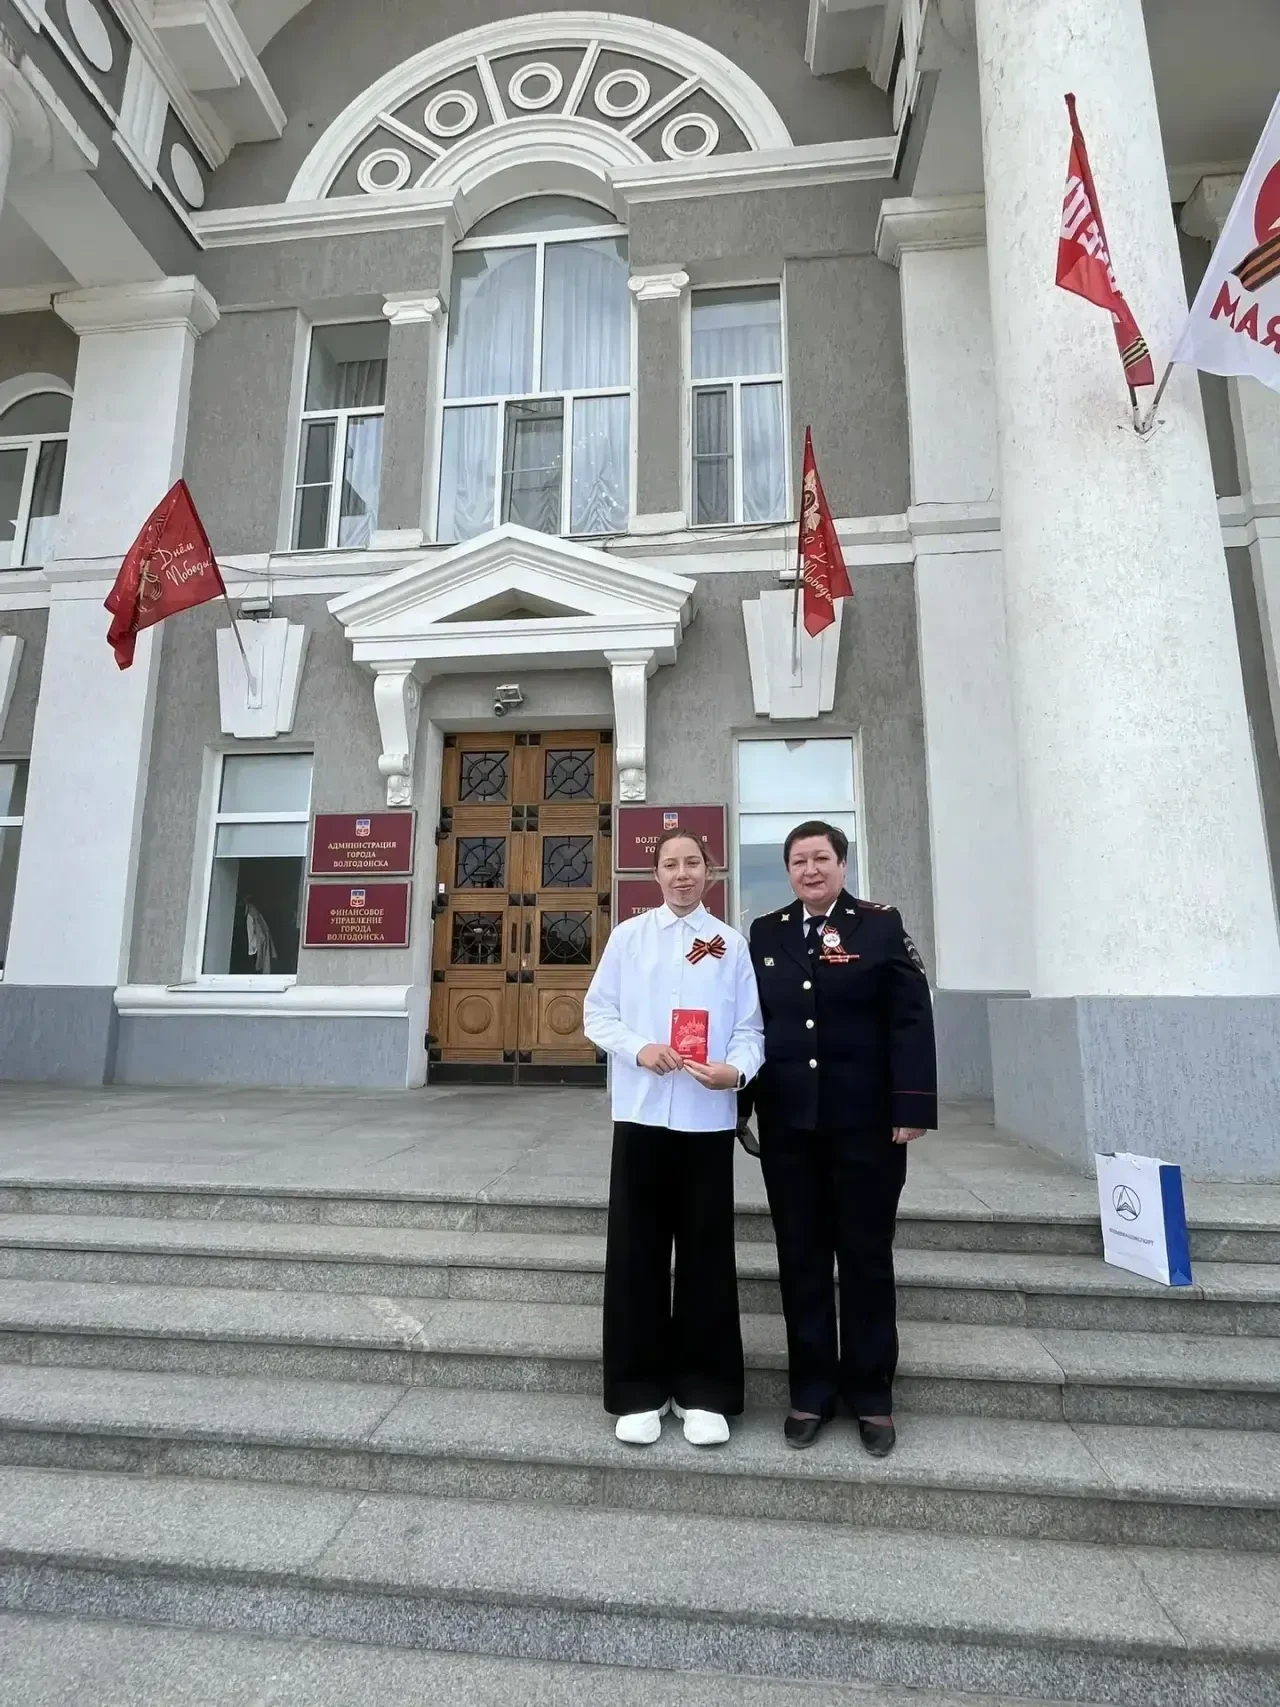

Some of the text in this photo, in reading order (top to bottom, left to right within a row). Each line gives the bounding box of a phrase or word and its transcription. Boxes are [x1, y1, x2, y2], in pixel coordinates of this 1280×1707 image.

[1210, 280, 1280, 354] МАЯ
[152, 543, 194, 570] Днём
[166, 547, 212, 586] Победы!
[327, 933, 384, 941] ВОЛГОДОНСКА
